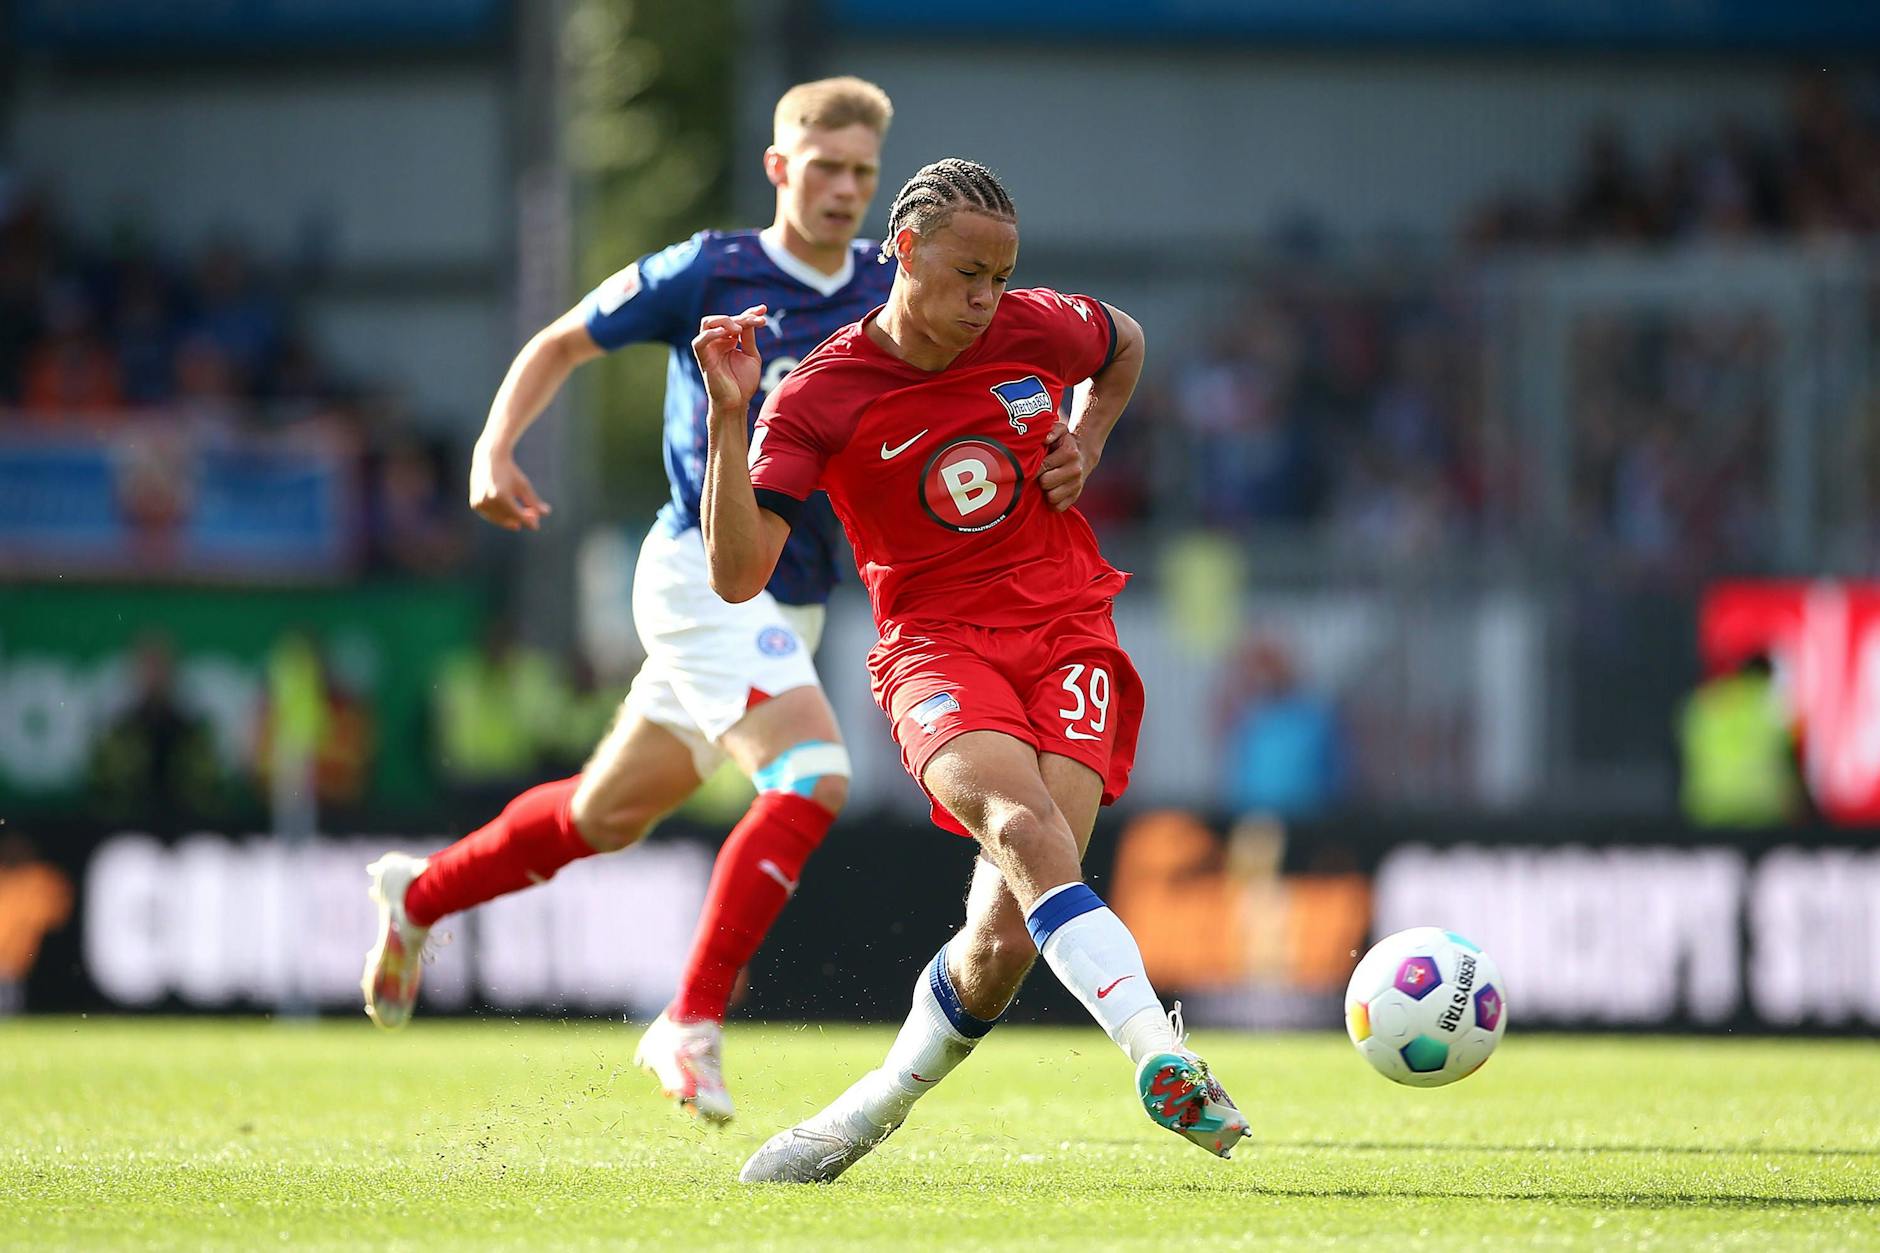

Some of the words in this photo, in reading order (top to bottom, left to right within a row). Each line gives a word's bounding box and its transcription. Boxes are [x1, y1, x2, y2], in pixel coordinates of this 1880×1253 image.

[941, 458, 997, 516] B
[1058, 664, 1109, 733] 39
[1440, 954, 1477, 1033] DERBYSTAR
